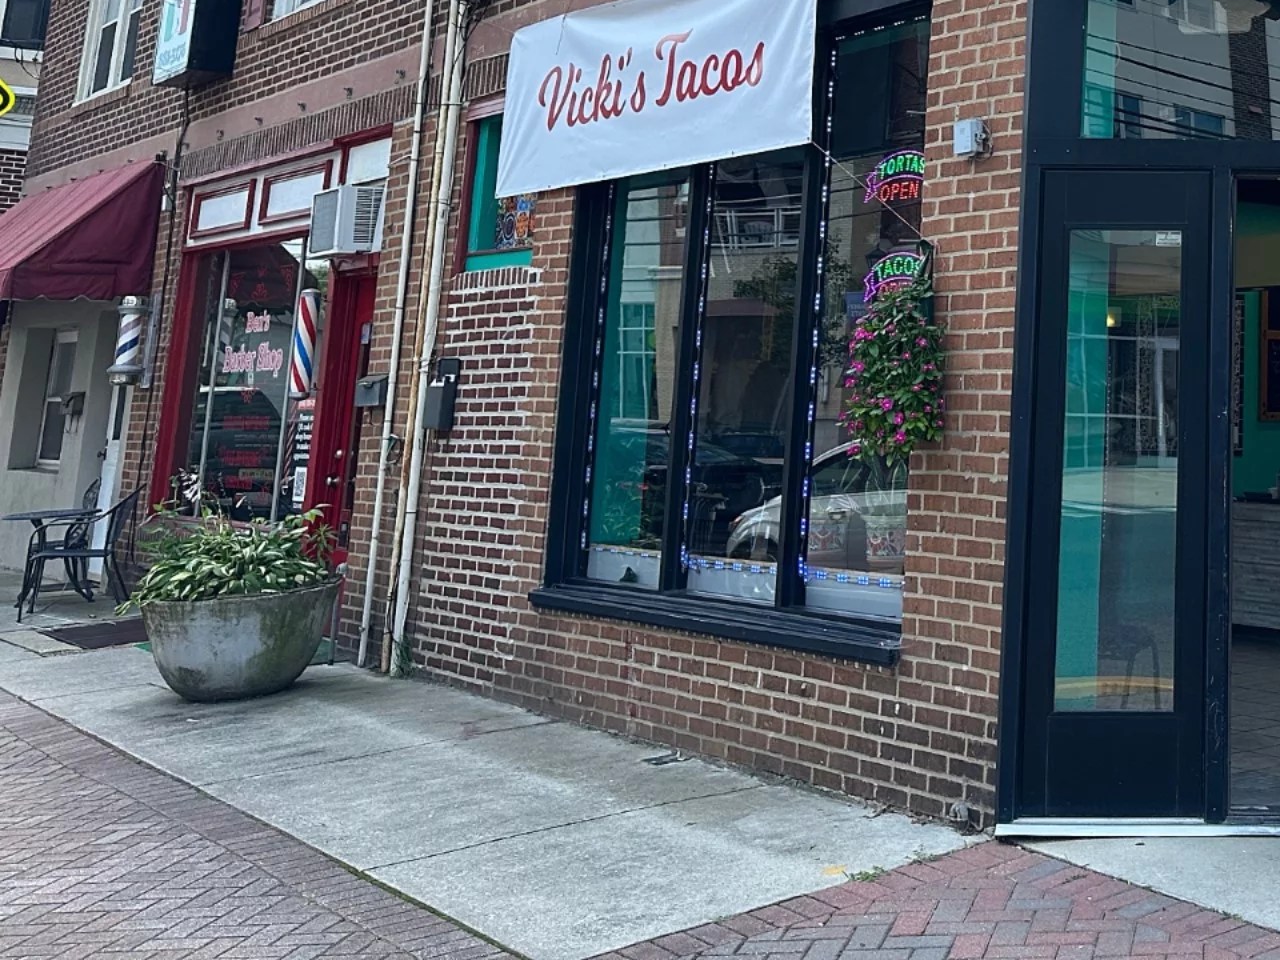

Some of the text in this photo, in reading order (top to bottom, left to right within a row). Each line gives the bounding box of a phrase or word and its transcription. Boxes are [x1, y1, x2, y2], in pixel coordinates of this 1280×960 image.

[538, 28, 765, 132] Vicki's Tacos
[879, 154, 925, 180] TORTAS
[879, 180, 920, 202] OPEN
[245, 309, 270, 333] Ben's
[222, 341, 284, 378] Barber Shop
